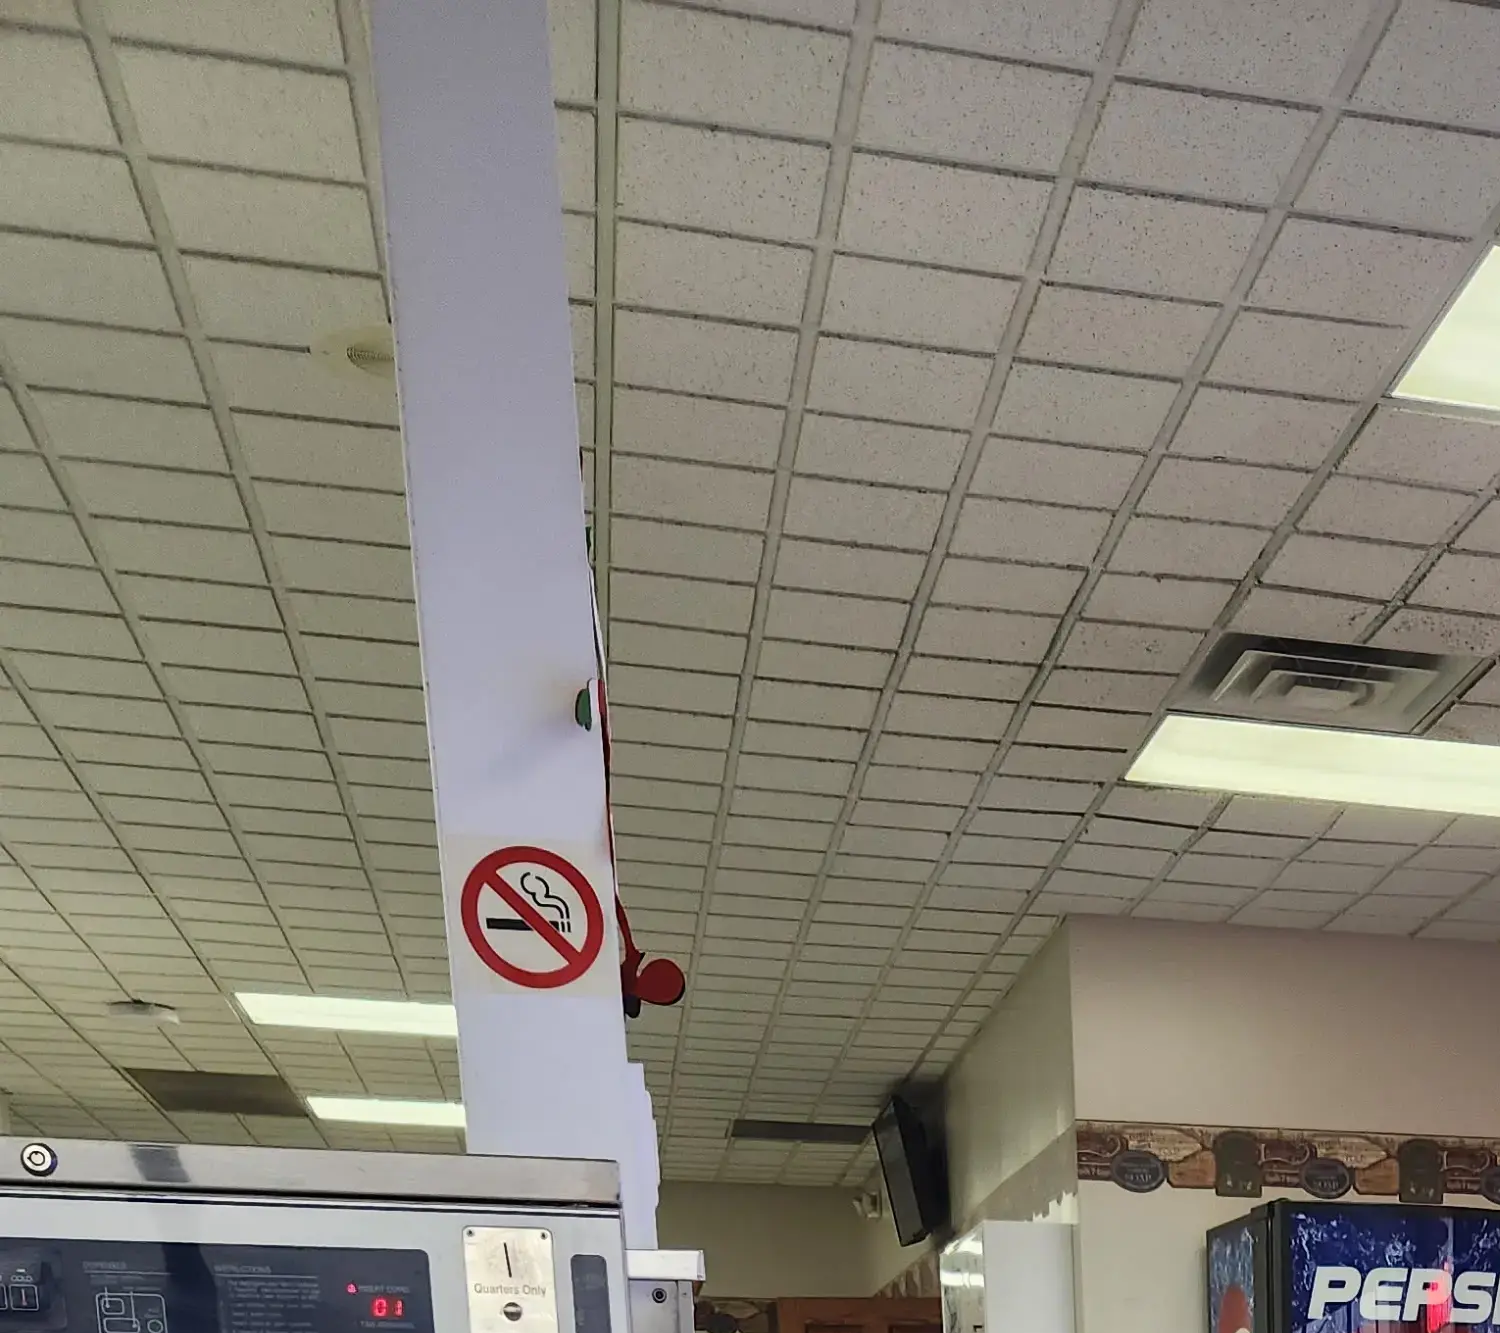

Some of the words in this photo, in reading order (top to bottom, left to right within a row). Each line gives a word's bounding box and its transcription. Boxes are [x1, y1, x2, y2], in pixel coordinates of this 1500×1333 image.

[474, 1284, 519, 1294] Quarters
[522, 1285, 547, 1297] Only
[373, 1298, 404, 1317] 01
